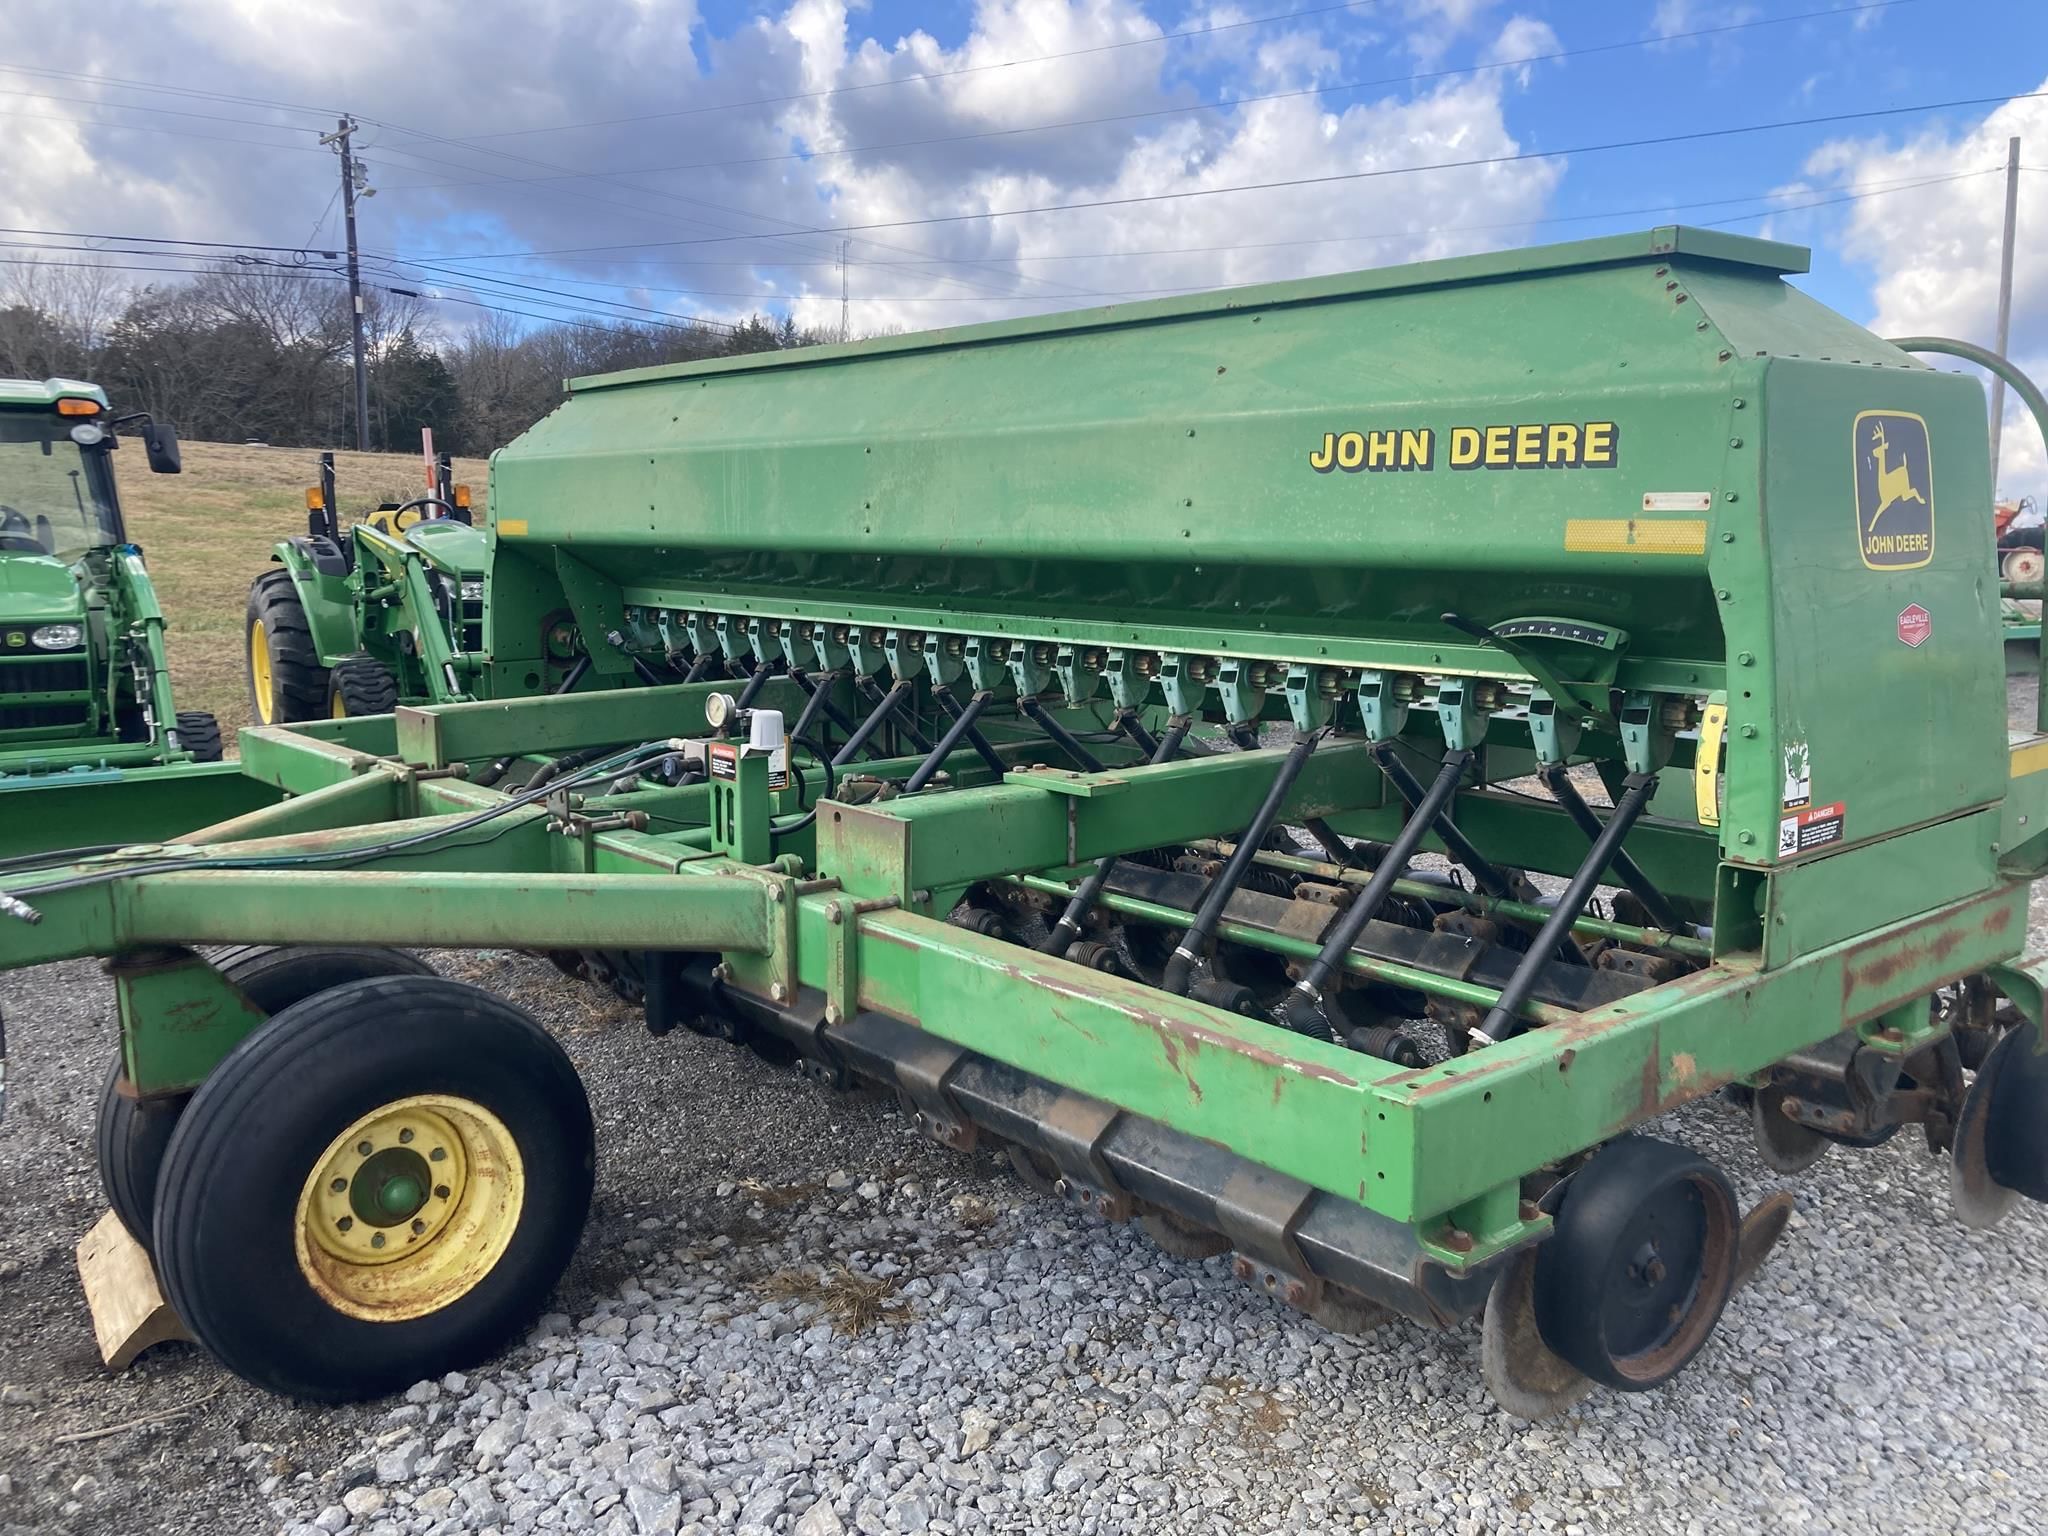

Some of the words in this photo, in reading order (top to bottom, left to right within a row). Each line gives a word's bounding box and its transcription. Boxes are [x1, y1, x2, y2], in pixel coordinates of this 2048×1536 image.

[1310, 429, 1433, 472] JOHN
[1450, 422, 1618, 470] DEERE
[1866, 536, 1894, 554] JOHN
[1897, 534, 1928, 552] DEERE
[1900, 613, 1929, 624] EAGLEVILLE
